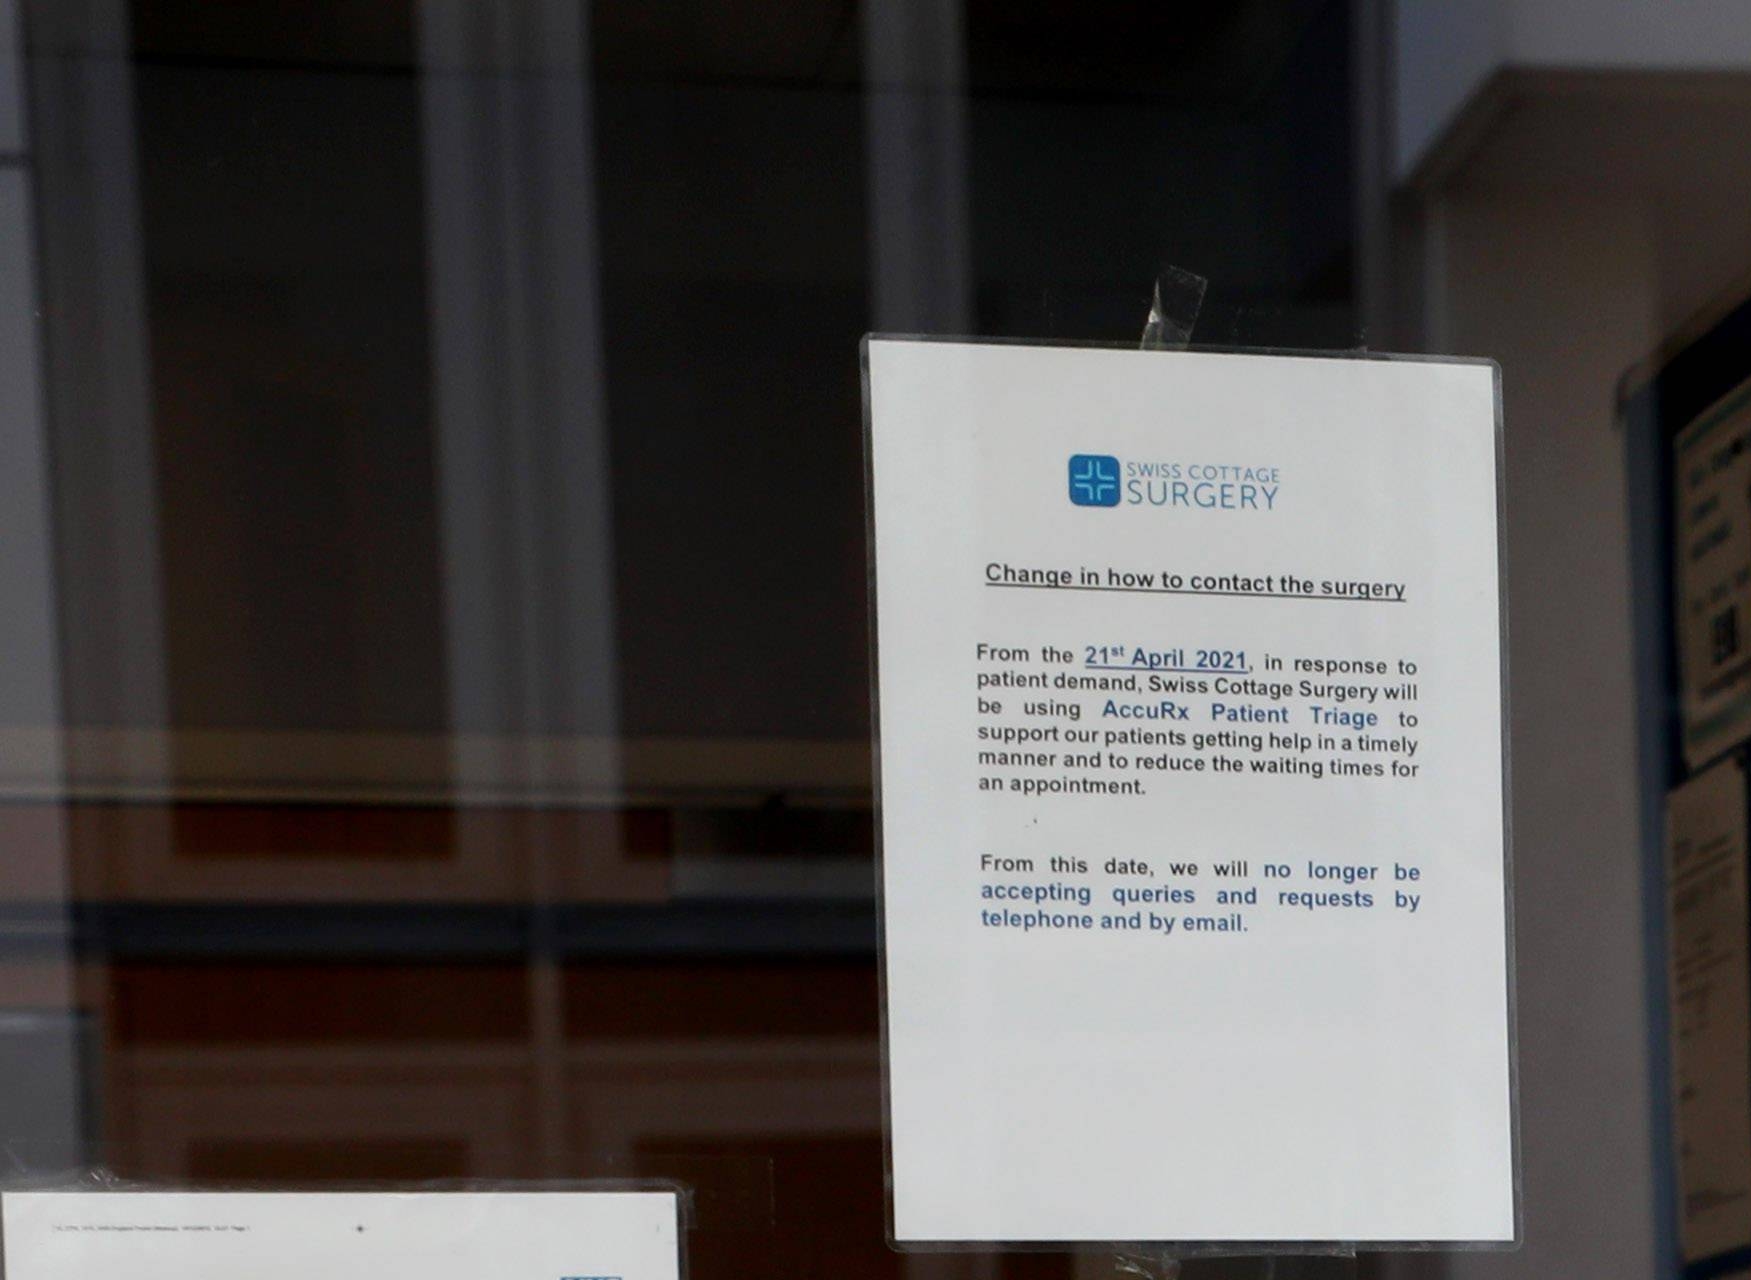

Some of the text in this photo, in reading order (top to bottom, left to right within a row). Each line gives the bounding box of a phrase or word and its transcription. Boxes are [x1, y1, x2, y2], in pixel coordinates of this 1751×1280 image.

[1126, 461, 1280, 484] SWISS COTTAGE
[1127, 479, 1279, 510] SURGERY
[985, 562, 1405, 602] Change in how to contact the surgery
[976, 642, 1029, 661] From
[1041, 645, 1074, 663] the
[1130, 647, 1184, 672] April
[1195, 649, 1253, 674] 2021,
[1264, 653, 1282, 670] in
[1293, 658, 1387, 676] response
[1397, 659, 1417, 675] to
[976, 670, 1417, 703] patient demand, Swiss Cottage Surgery will
[977, 696, 1418, 730] be using AccuRx Patient Triage to
[978, 776, 1146, 795] an appointment.
[980, 853, 1420, 884] From this date, we will no longer be
[980, 882, 1420, 912] accepting queries and requests by
[980, 908, 1248, 934] telephone and by email.
